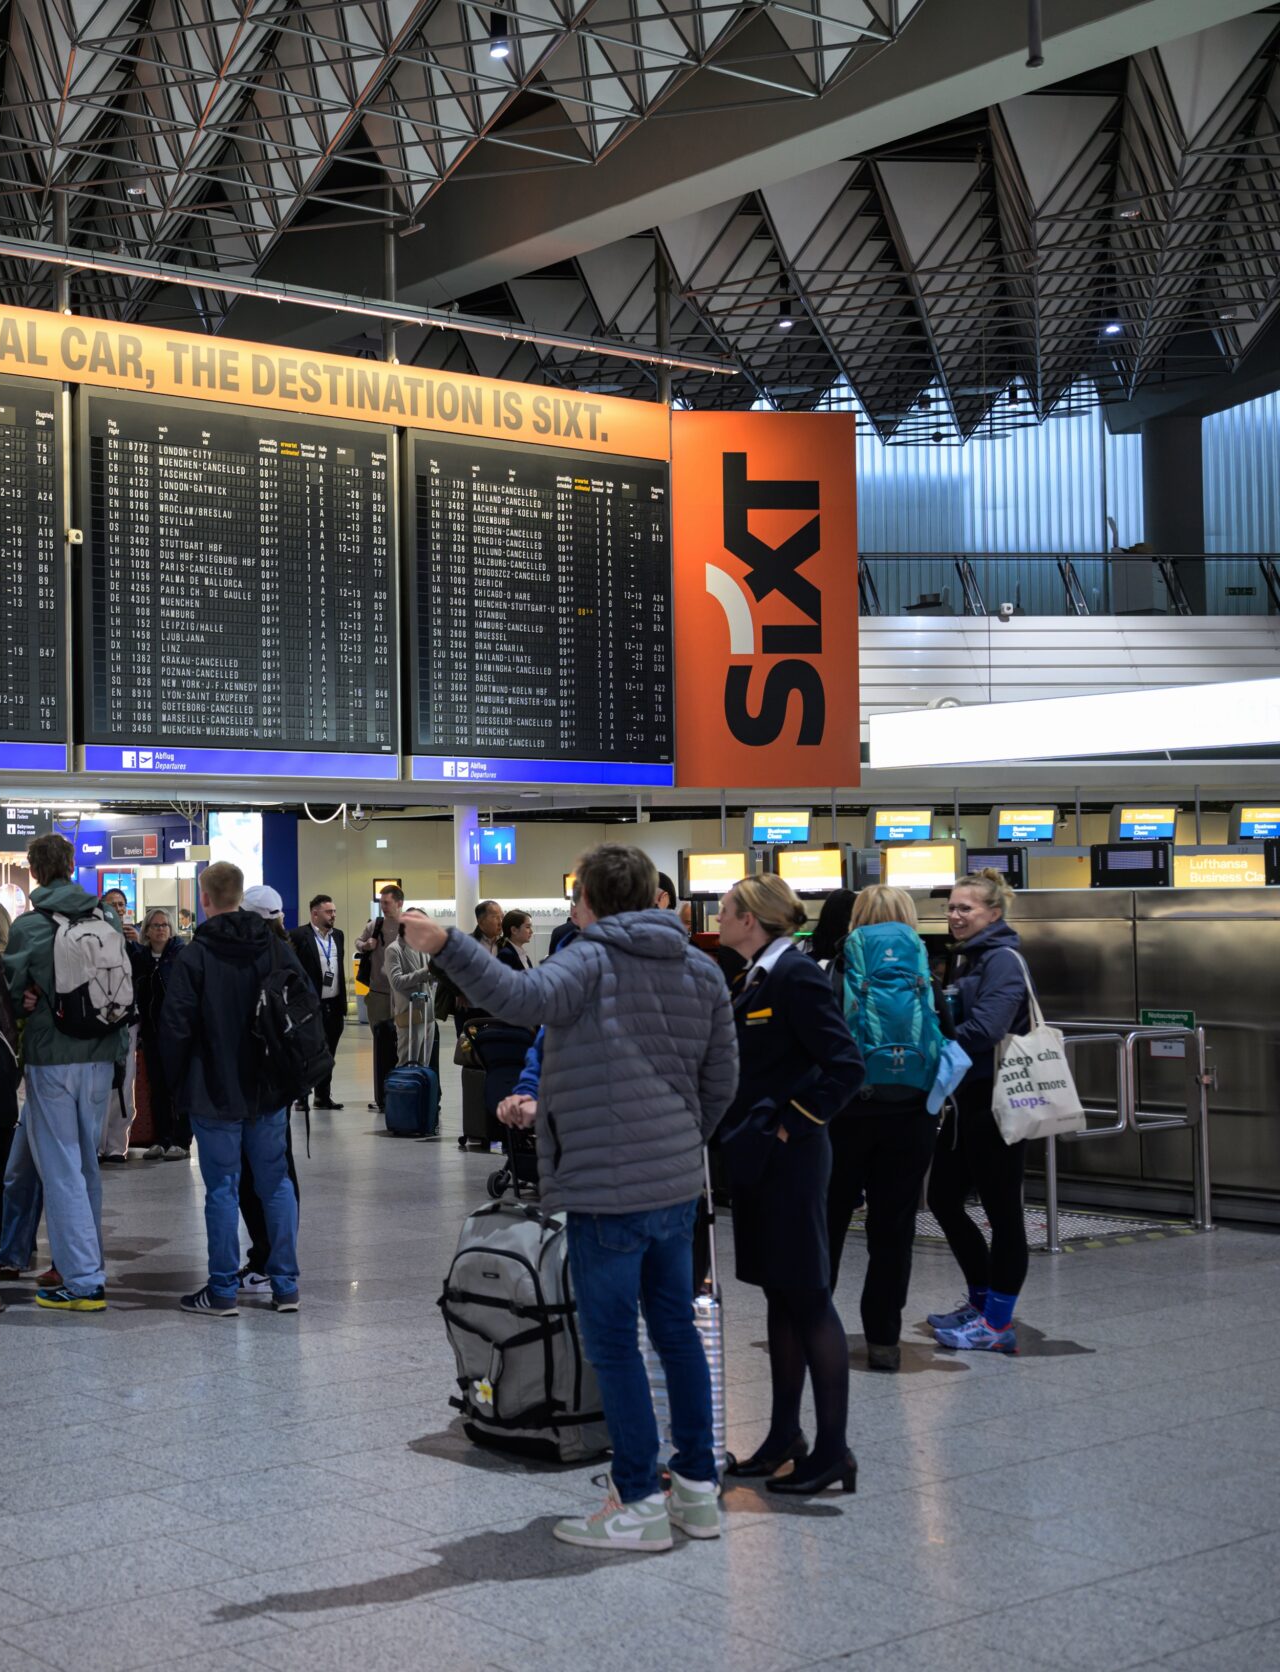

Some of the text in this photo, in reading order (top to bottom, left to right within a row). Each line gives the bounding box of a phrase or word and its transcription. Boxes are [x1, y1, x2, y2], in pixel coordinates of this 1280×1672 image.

[61, 327, 154, 389] CAR,
[166, 341, 239, 392] THE
[252, 354, 482, 425] DESTINATION
[493, 390, 521, 431] IS
[532, 396, 608, 442] SIXT.
[159, 445, 212, 460] LONDON-CITY
[159, 457, 245, 475] MUENCHEN-CANCELLED
[159, 469, 202, 481] TASCHKENT
[159, 480, 226, 495] LONDON-GATWICK
[159, 504, 231, 519] WROCLAW/BRESLAU
[160, 515, 193, 526] SEVILLA
[160, 562, 232, 576] PARIS-CANCELLED
[706, 452, 825, 747] SIXT
[161, 608, 194, 618] HAMBURG
[161, 620, 223, 632] LEIPZIG/HALLE
[161, 632, 204, 642] LJUBLJANA
[161, 655, 238, 667] KRAKAU-CANCELLED
[161, 666, 238, 678] POZNAN-CANCELLED
[162, 701, 252, 713] GOETEBORG-CANCELLED
[162, 713, 253, 724] MARSEILLE-CANCELLED
[155, 752, 174, 761] Abflug
[155, 762, 186, 770] Departures
[82, 843, 103, 855] Change
[123, 847, 142, 855] Travelex
[494, 842, 512, 861] 11
[1189, 858, 1248, 869] Lufthansa
[1190, 872, 1265, 883] Business Cla
[999, 1055, 1033, 1069] Keep
[1002, 1068, 1030, 1082] and
[1006, 1080, 1067, 1095] add more
[1008, 1096, 1050, 1109] hops.
